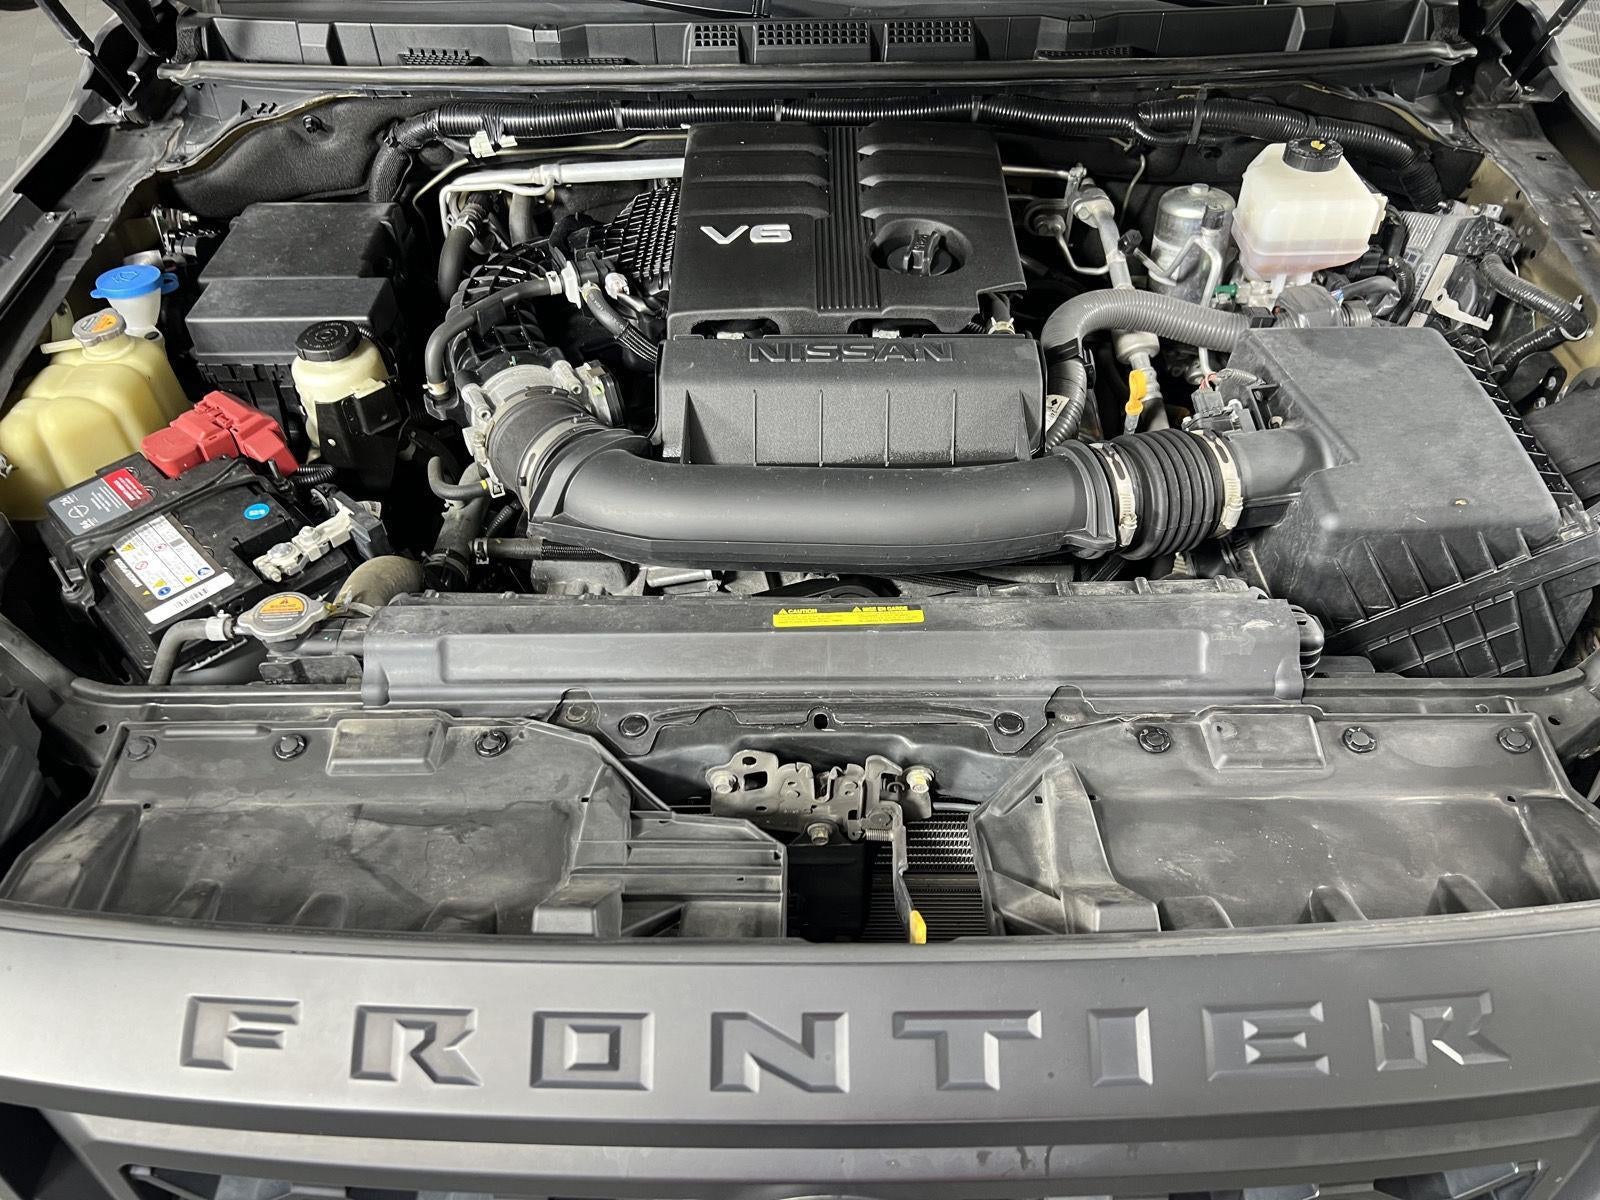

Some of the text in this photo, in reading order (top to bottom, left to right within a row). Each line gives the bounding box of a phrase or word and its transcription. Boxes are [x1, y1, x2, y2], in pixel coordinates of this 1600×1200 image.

[699, 223, 793, 245] V6
[748, 342, 954, 363] NISSAN
[178, 990, 1511, 1093] FRONTIER
